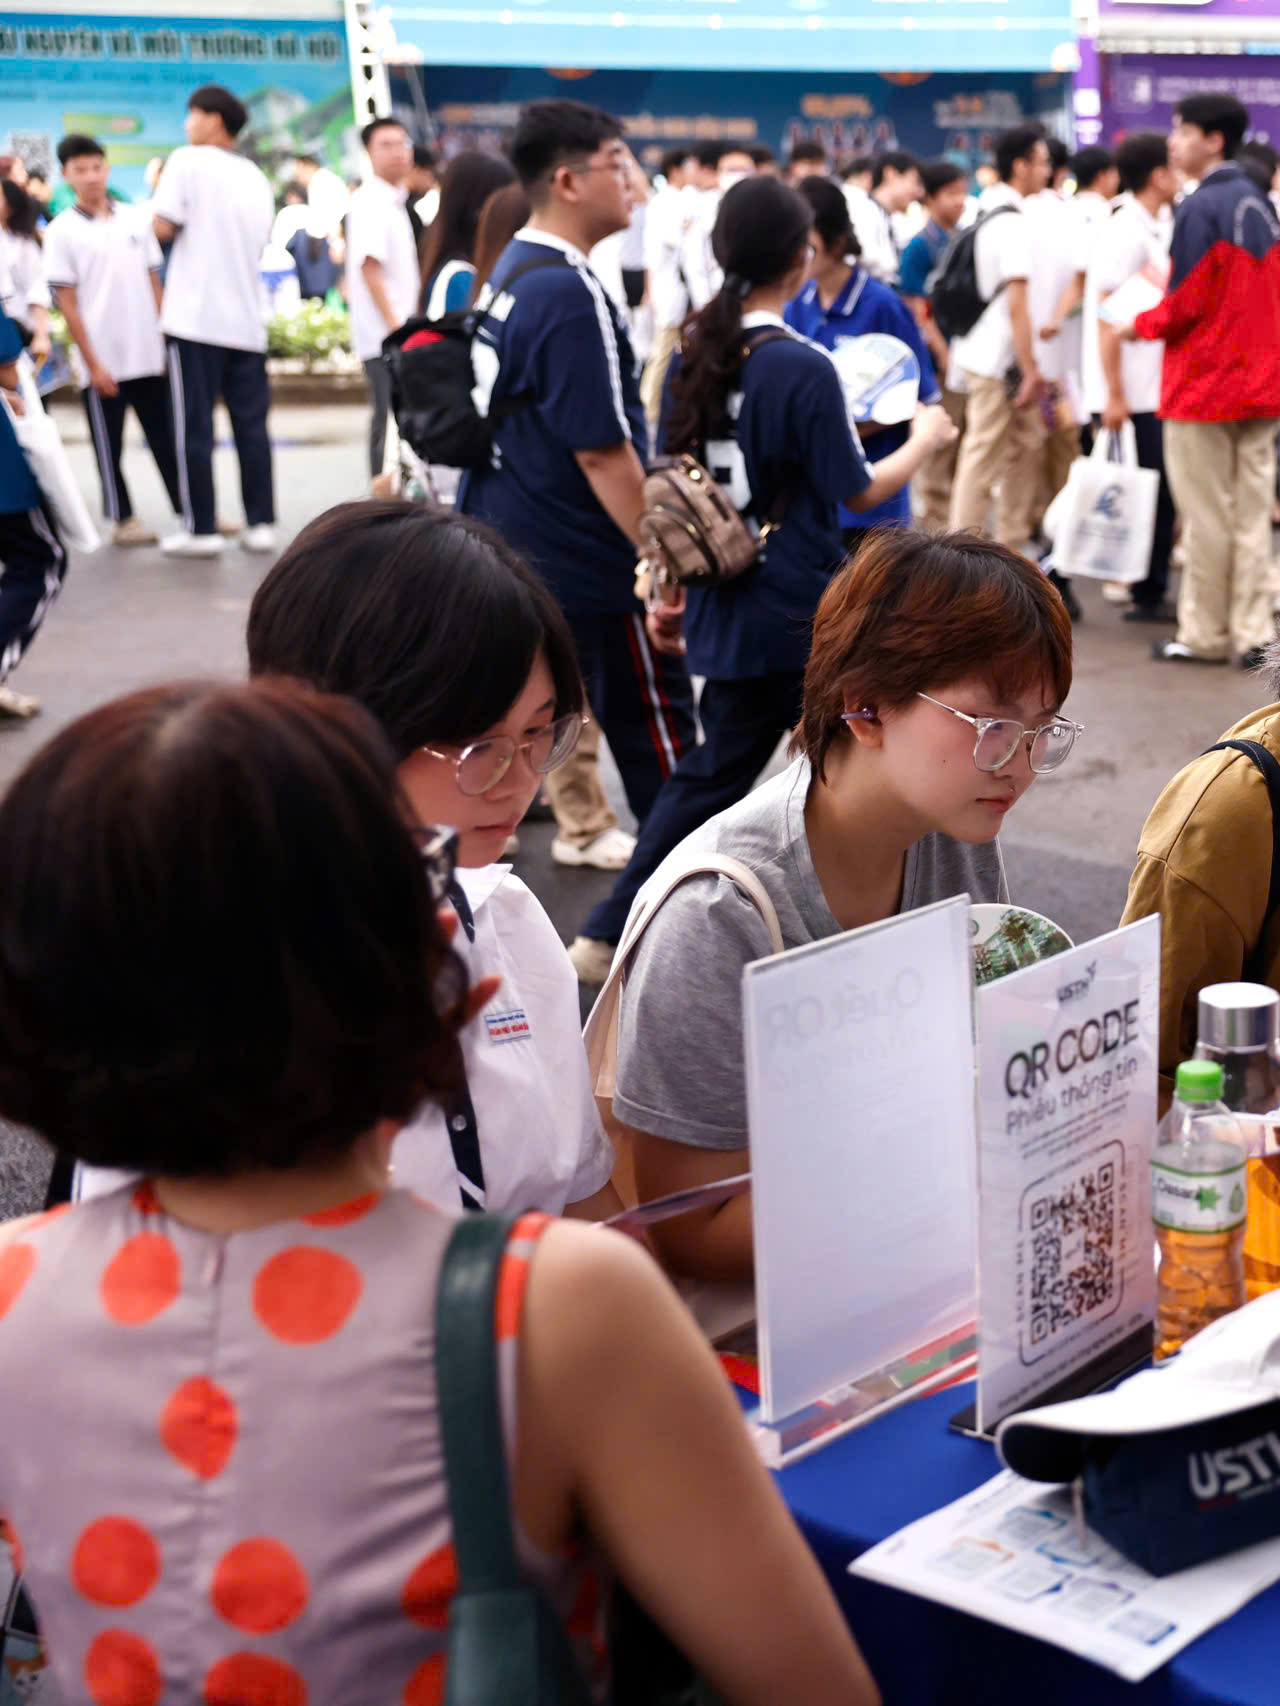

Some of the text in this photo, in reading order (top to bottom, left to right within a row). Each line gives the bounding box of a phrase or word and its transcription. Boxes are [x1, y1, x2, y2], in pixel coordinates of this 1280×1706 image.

[1005, 1041, 1049, 1099] QR
[1055, 998, 1140, 1075] CODE
[1116, 1055, 1138, 1083] tin
